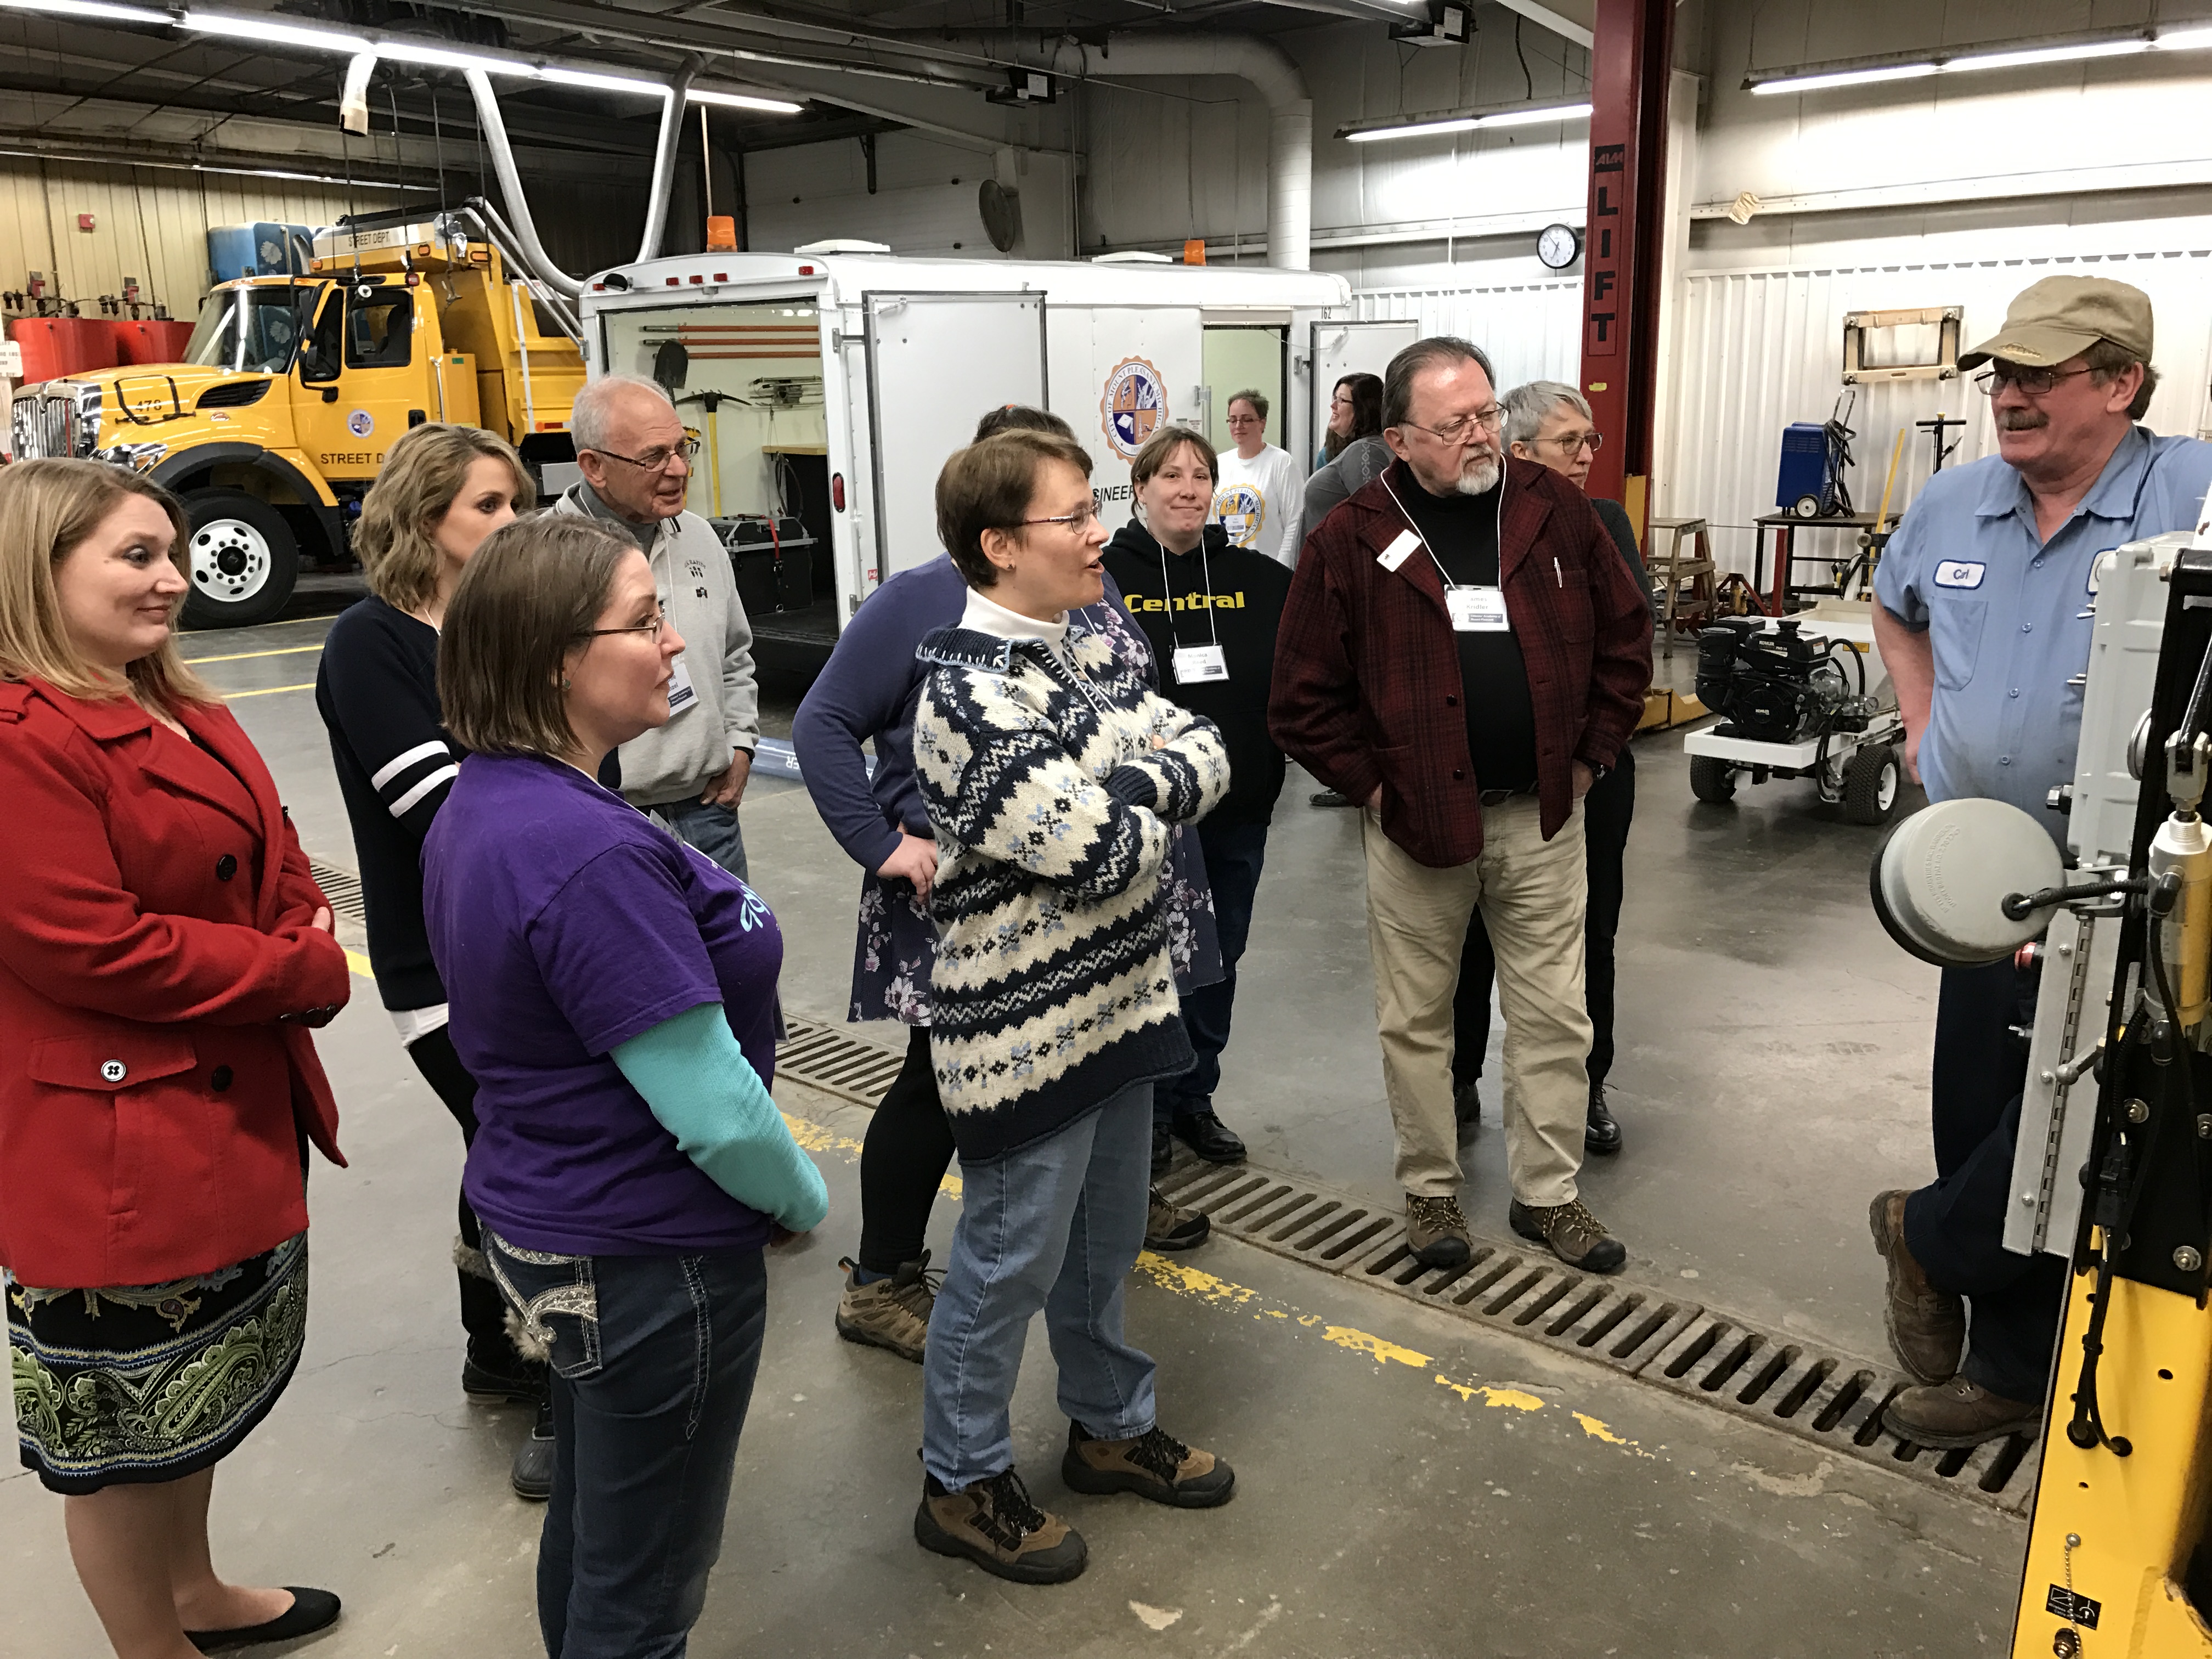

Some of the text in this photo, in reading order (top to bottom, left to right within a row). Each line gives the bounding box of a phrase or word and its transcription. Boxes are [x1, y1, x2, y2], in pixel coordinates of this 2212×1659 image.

[348, 234, 371, 247] SREET
[1591, 186, 1618, 342] LIFT
[1321, 307, 1331, 319] 162
[1109, 370, 1127, 398] MOUNT
[1107, 402, 1113, 413] OF
[1153, 387, 1163, 430] MICHIGA
[1107, 416, 1117, 438] CITY
[321, 453, 372, 464] STREET
[1124, 591, 1245, 613] Central
